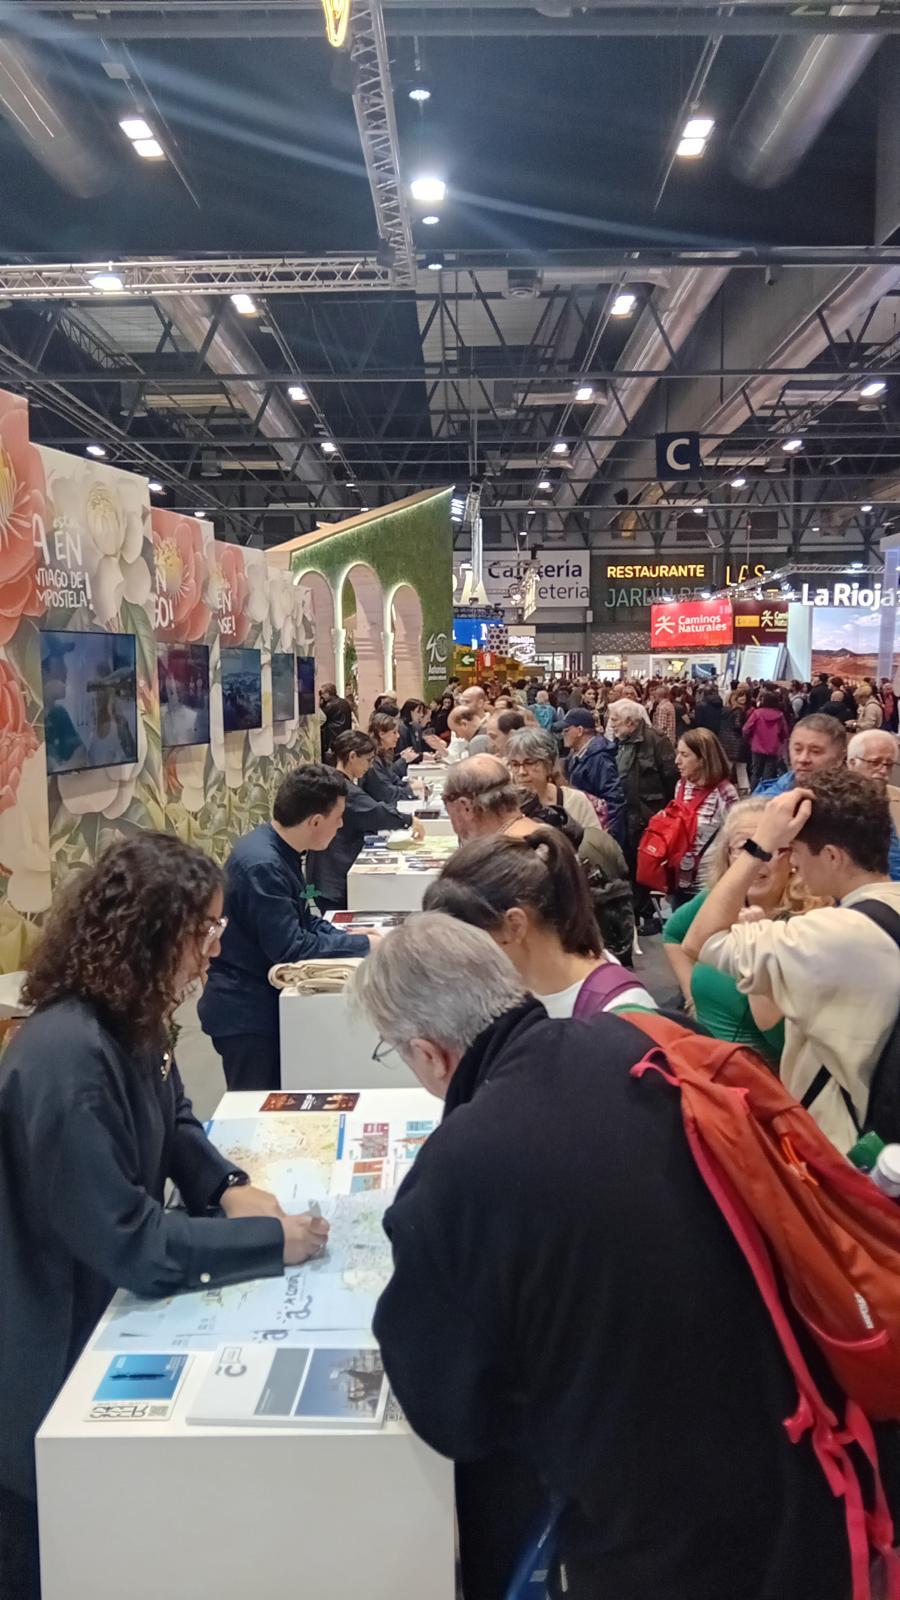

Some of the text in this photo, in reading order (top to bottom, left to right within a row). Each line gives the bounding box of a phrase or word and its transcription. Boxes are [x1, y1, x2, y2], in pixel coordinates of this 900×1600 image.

[666, 438, 691, 471] C
[54, 530, 83, 569] EN
[607, 564, 705, 578] RESTAURANTE
[802, 583, 895, 611] La Rioja
[678, 615, 721, 624] Caminos
[678, 622, 727, 633] Naturales
